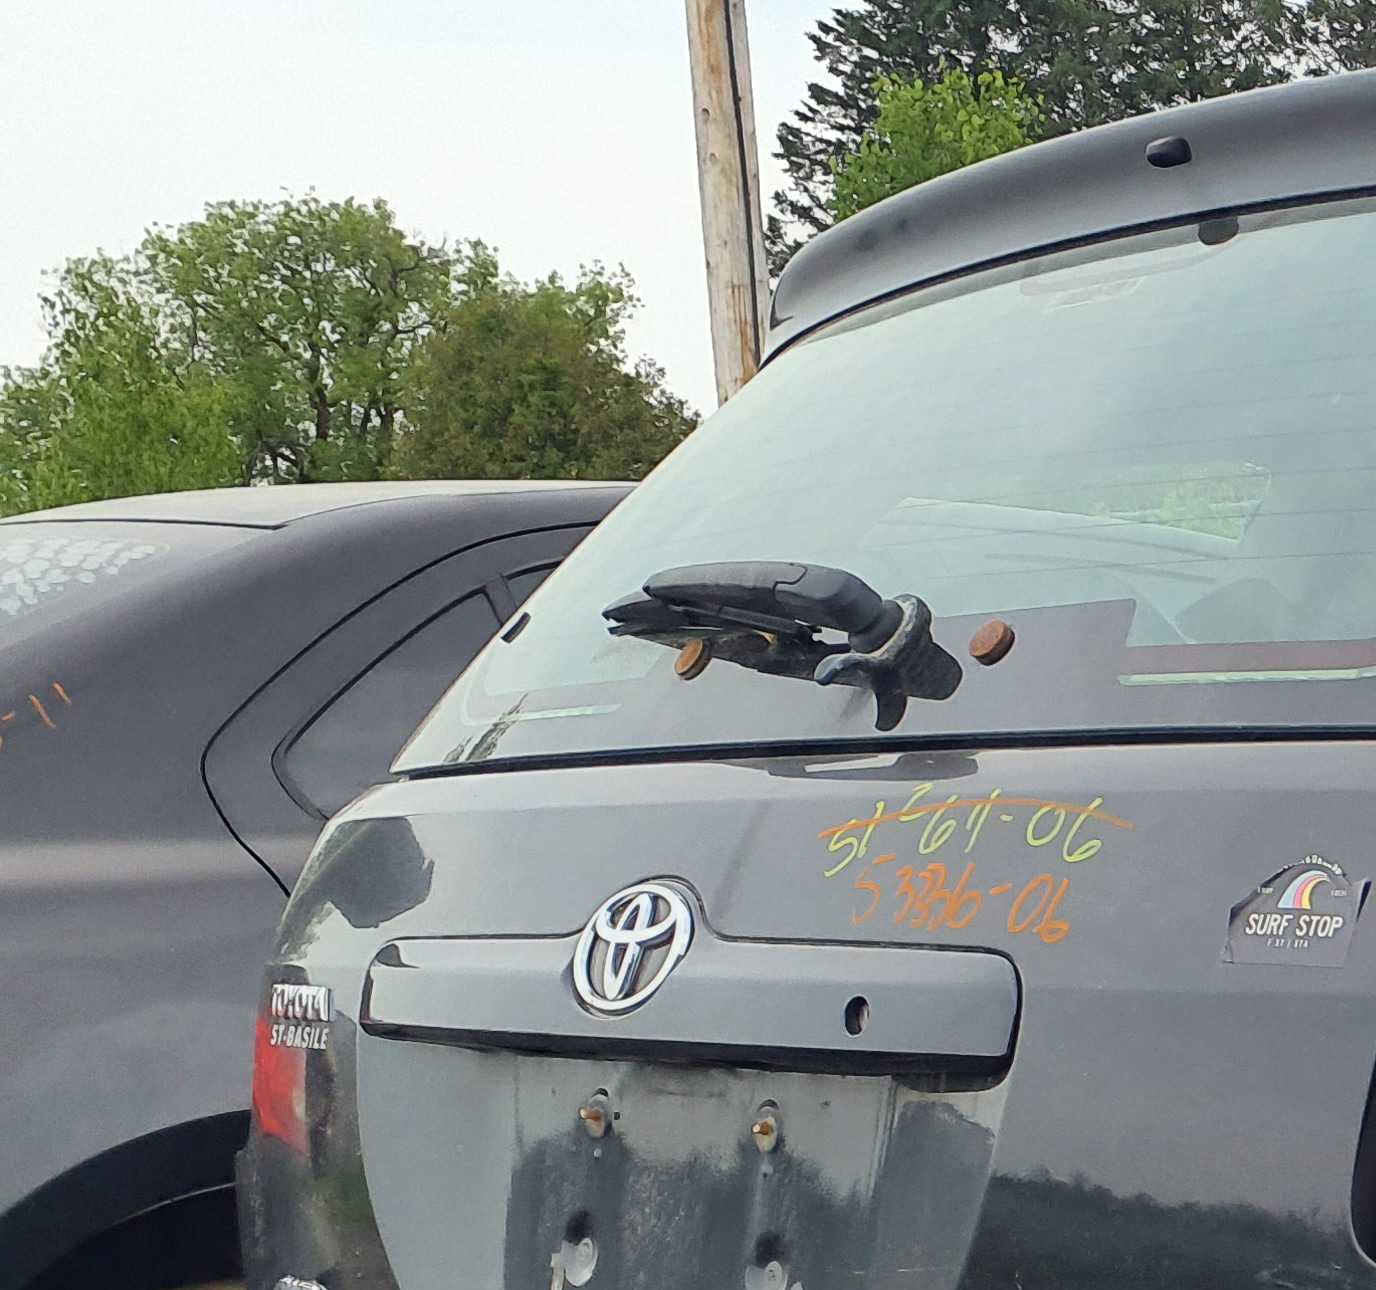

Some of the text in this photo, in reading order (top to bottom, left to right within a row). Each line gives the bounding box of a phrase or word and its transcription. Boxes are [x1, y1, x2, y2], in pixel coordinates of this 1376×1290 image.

[1245, 913, 1344, 938] SURF STOP
[271, 983, 333, 1023] TOYOTA
